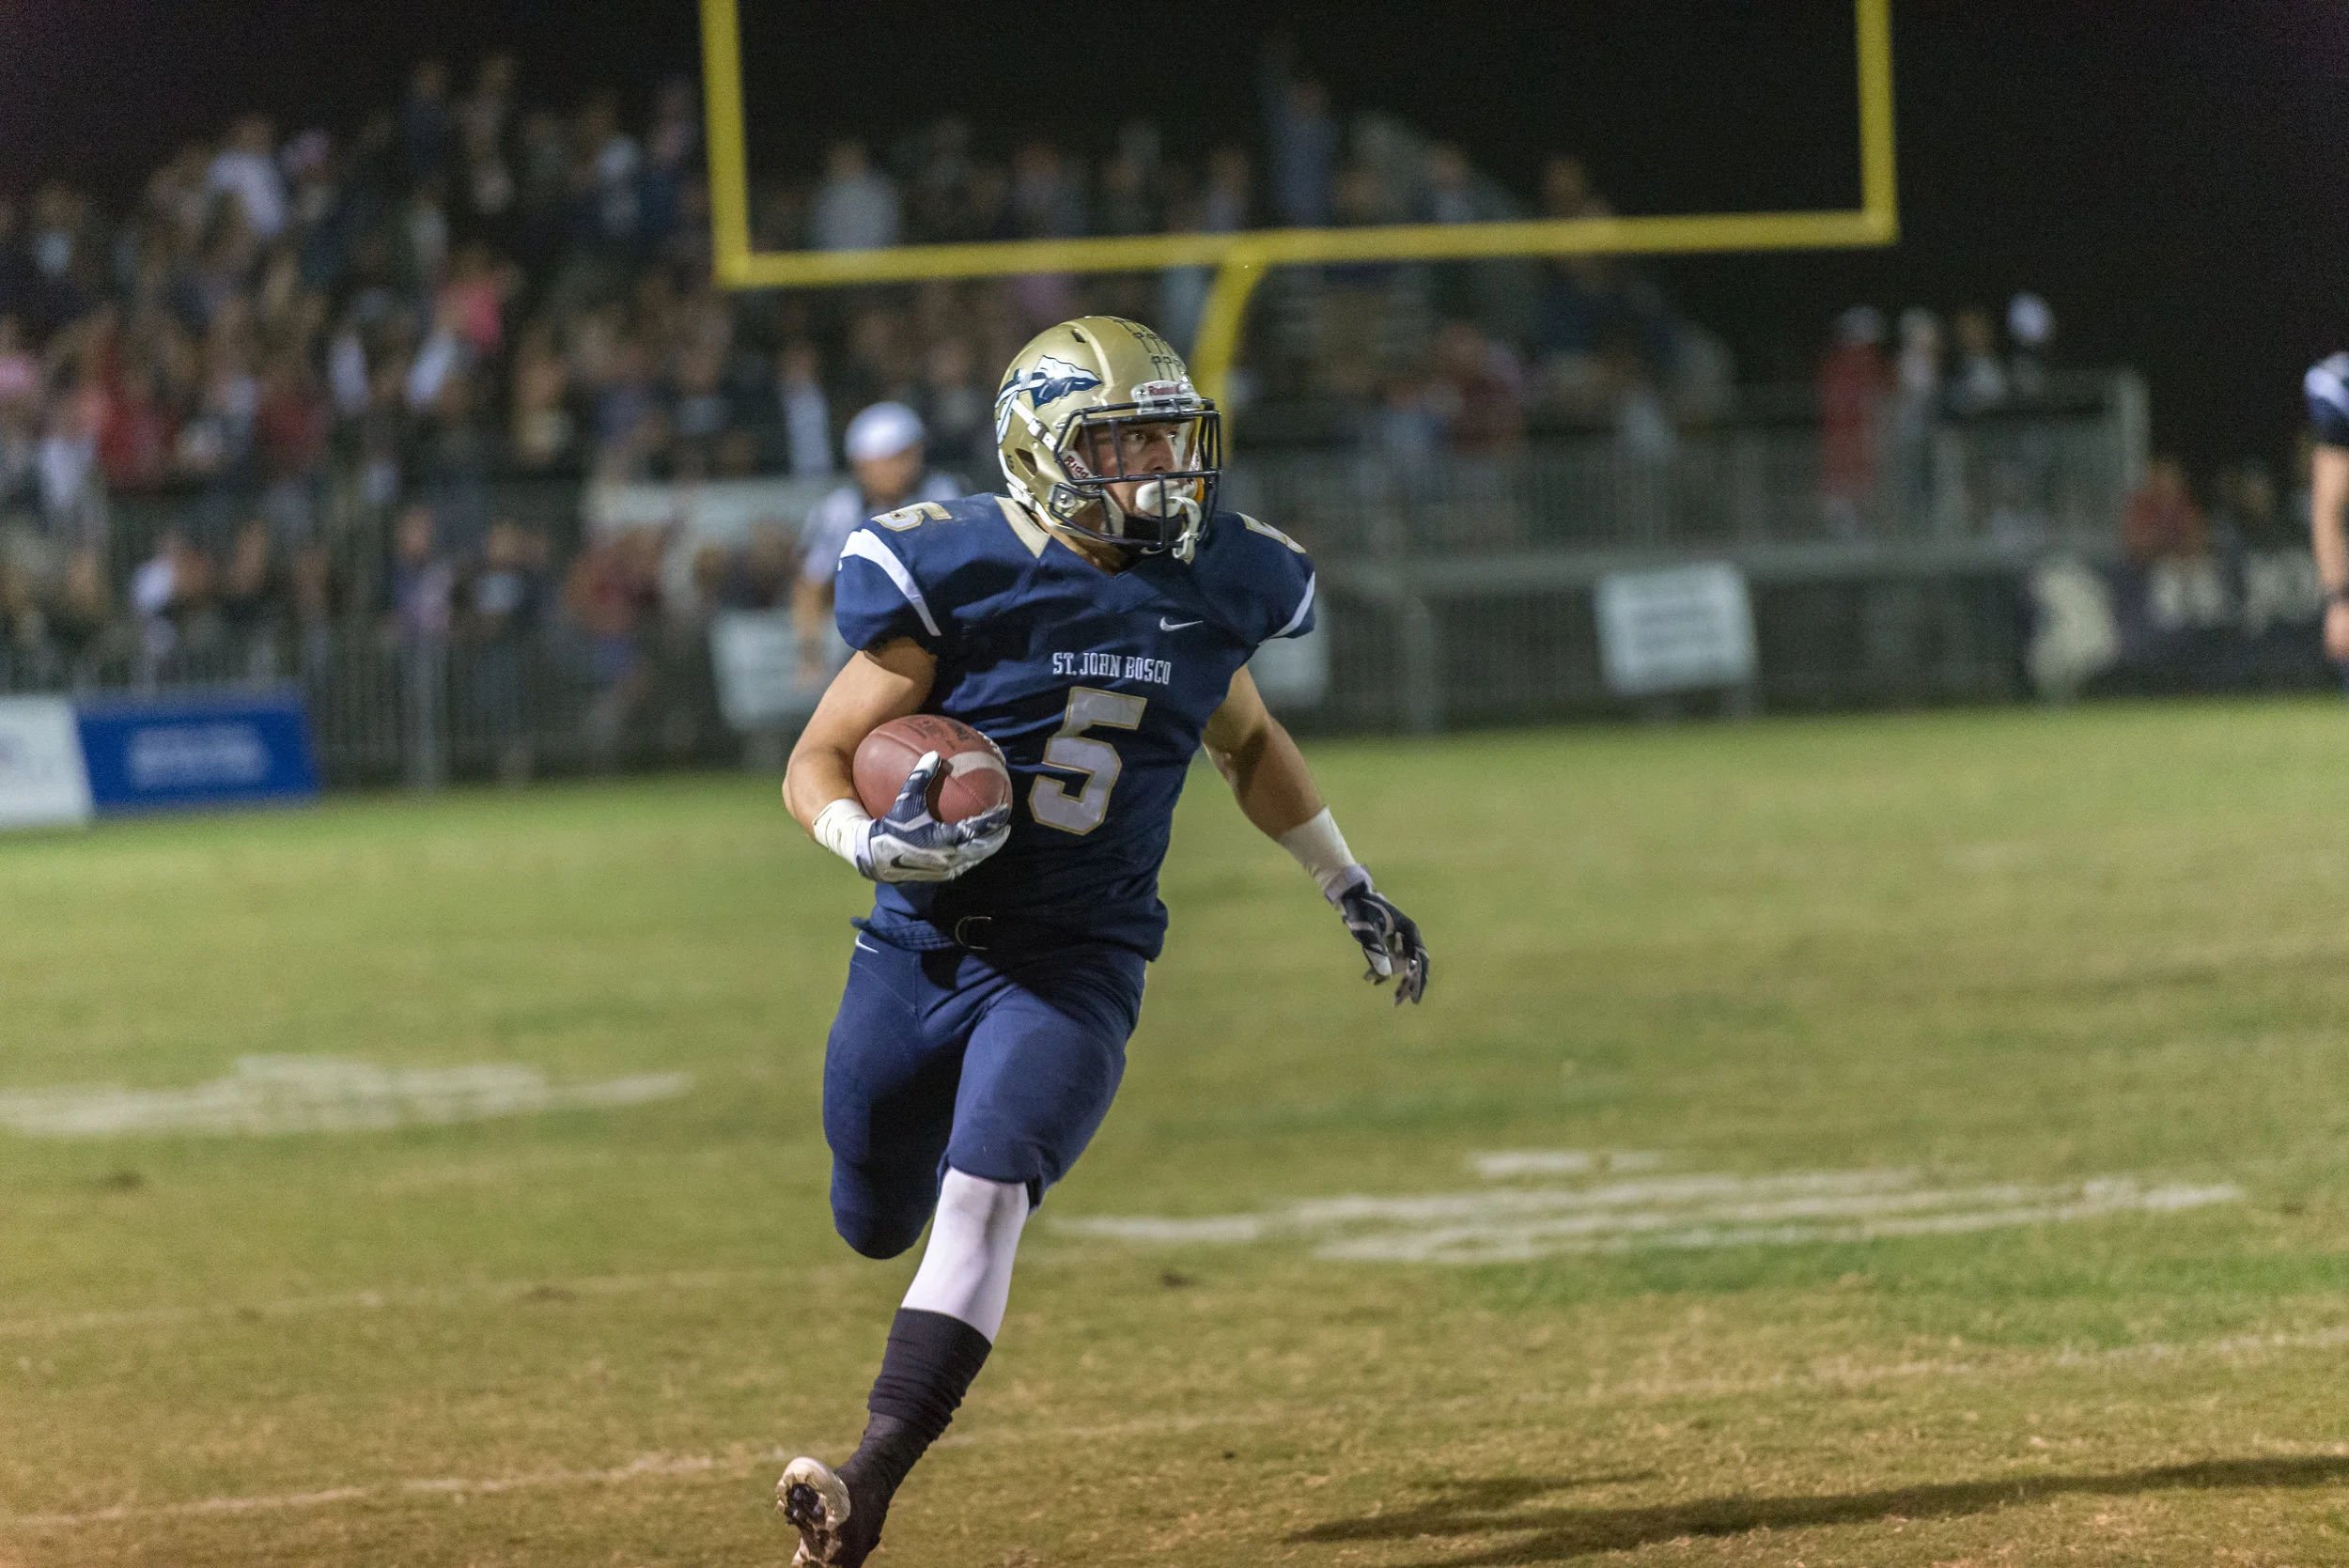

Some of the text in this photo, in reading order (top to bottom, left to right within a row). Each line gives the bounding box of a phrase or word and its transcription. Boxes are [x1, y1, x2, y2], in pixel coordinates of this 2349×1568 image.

[1051, 651, 1173, 686] ST. JOHN BOSCO
[1027, 685, 1149, 836] 5
